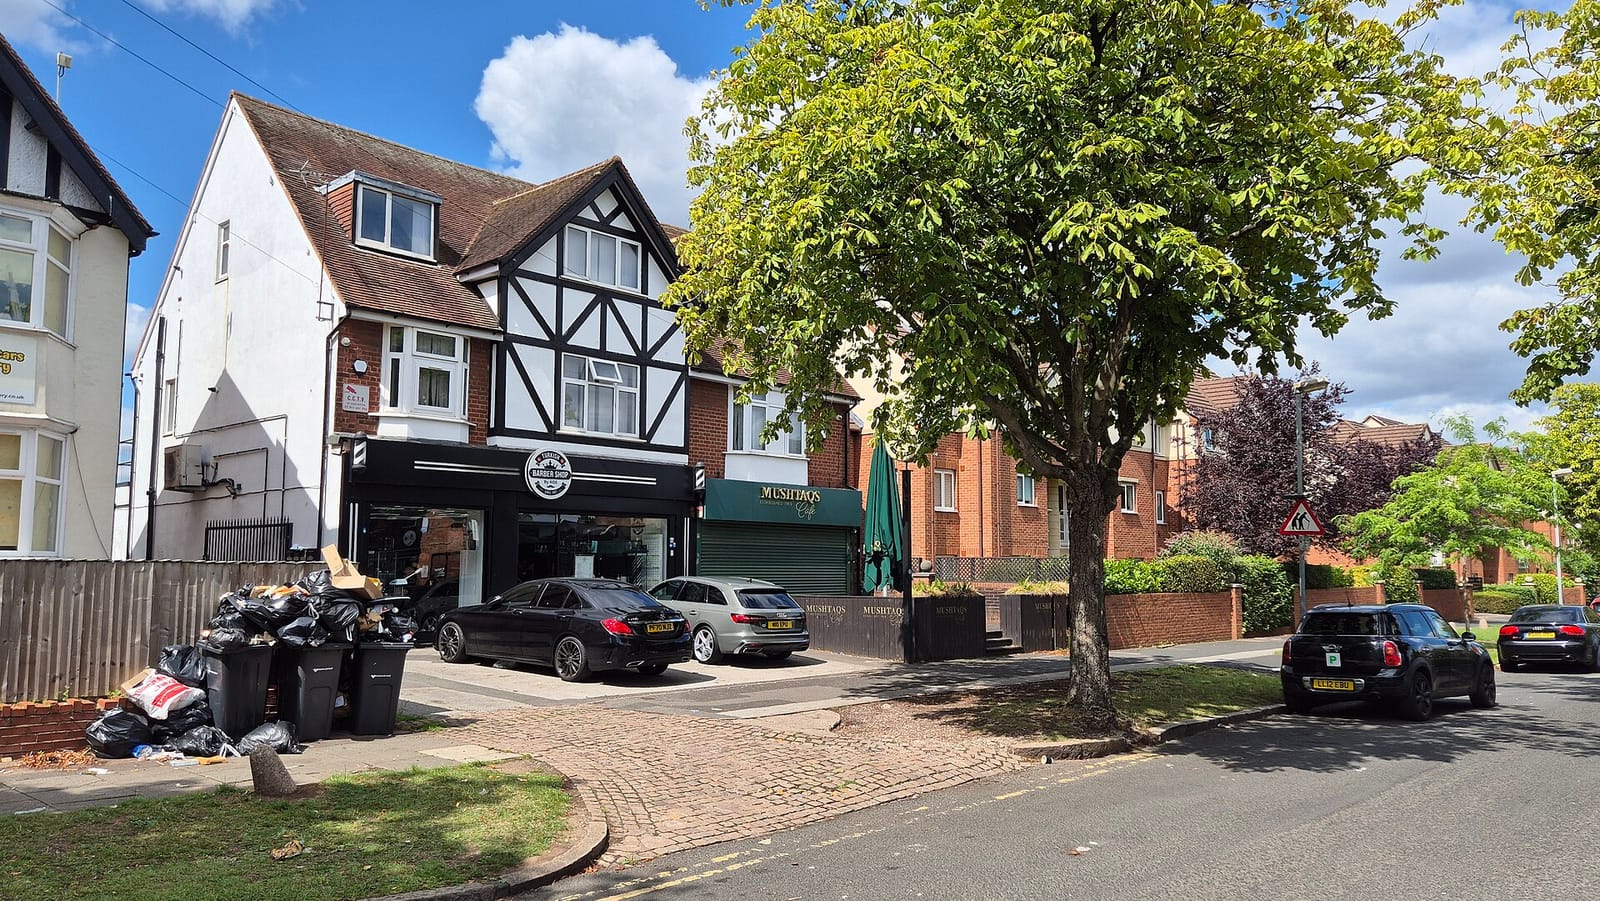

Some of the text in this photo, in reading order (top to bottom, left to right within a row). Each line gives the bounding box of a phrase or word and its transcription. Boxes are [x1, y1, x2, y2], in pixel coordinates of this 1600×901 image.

[541, 452, 561, 461] TURKISH
[532, 469, 569, 479] BARBER SHOP
[760, 486, 821, 503] MUSHTAQS
[806, 604, 847, 615] MUSHTAQS
[1329, 655, 1337, 664] P
[1317, 679, 1334, 688] LL12
